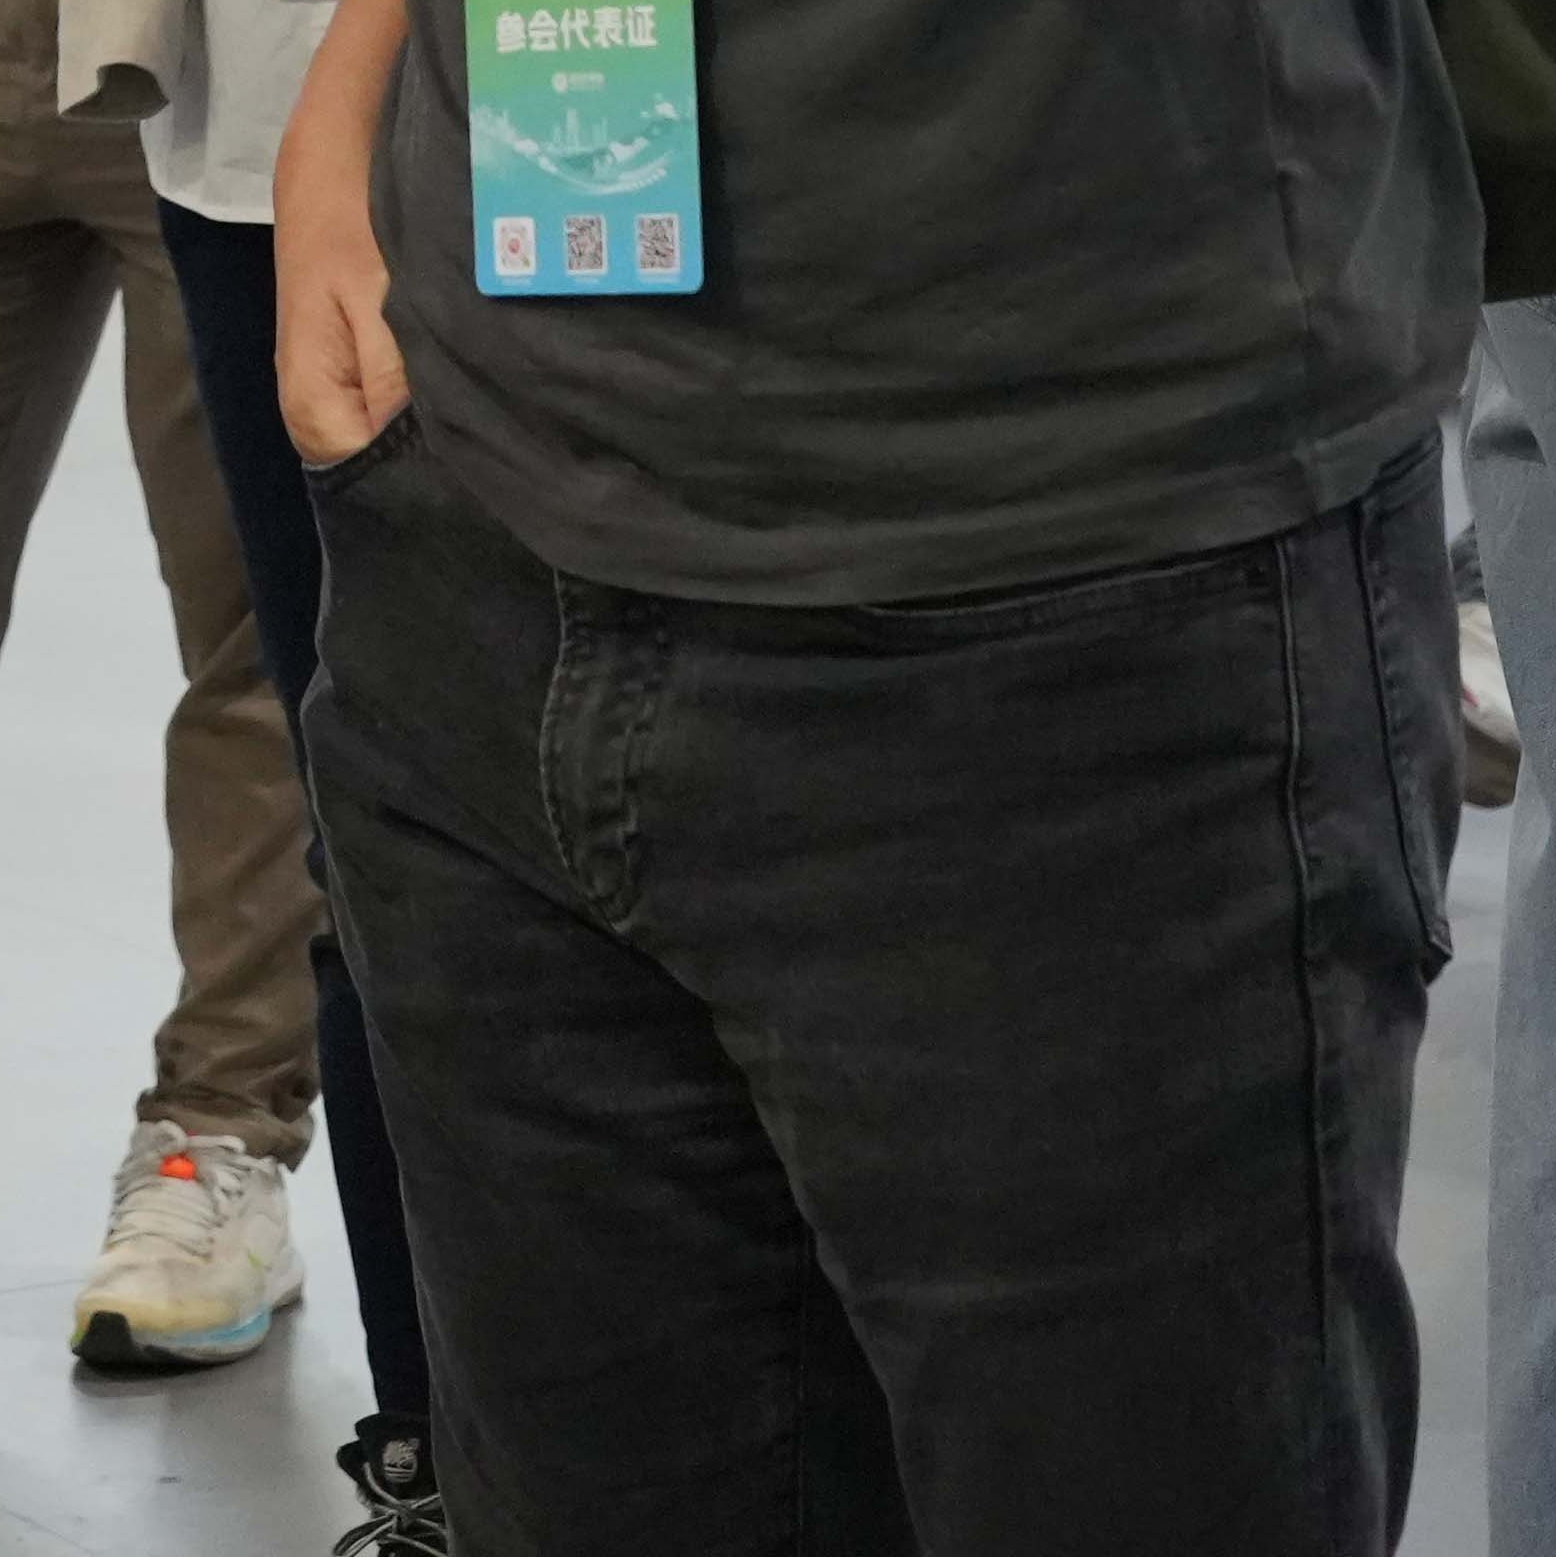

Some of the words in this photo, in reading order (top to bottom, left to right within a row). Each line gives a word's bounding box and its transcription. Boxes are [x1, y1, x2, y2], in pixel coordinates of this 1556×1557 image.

[496, 5, 657, 53] 参会代表证
